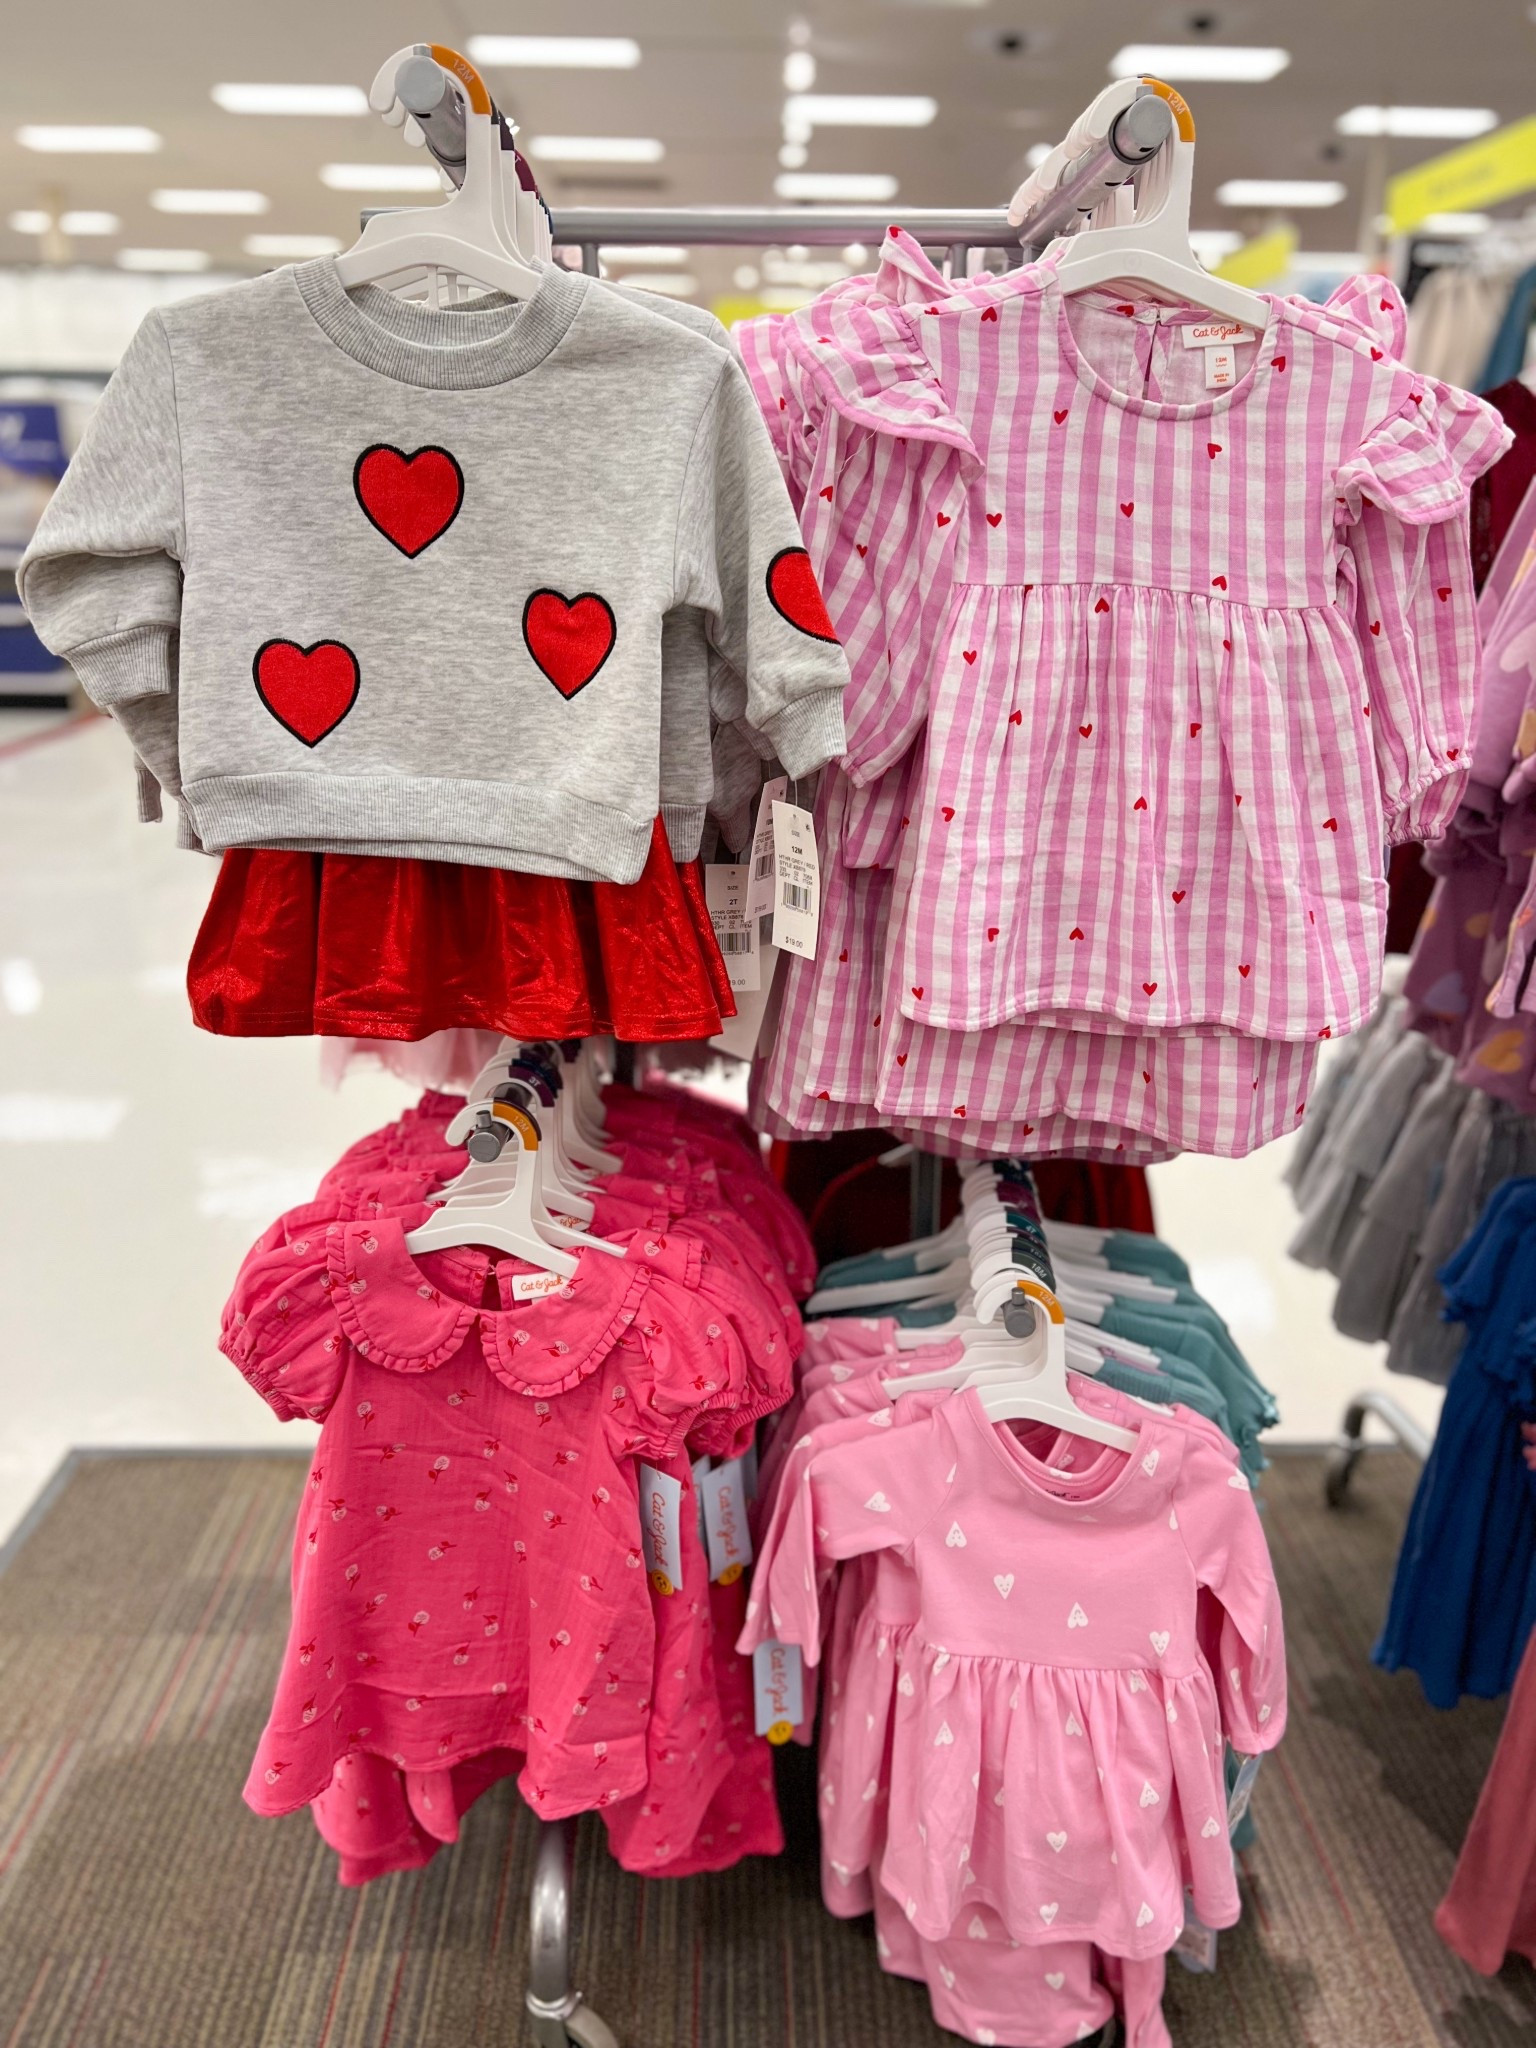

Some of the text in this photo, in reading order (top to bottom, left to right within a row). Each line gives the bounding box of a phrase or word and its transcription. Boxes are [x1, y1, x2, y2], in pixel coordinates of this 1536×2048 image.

[452, 58, 475, 84] 12M
[1167, 92, 1186, 115] 12M
[1193, 323, 1244, 340] Cat & Jack
[791, 845, 803, 855] 12M
[729, 898, 739, 906] 2T
[785, 936, 804, 948] $19.00
[528, 1076, 541, 1087] 3T
[513, 1115, 530, 1132] 12M
[1026, 1225, 1037, 1234] 4T
[1031, 1263, 1048, 1279] 18M
[520, 1275, 564, 1293] Cat & Jack
[1039, 1291, 1055, 1307] 12M
[646, 1492, 668, 1567] Cat & Jack
